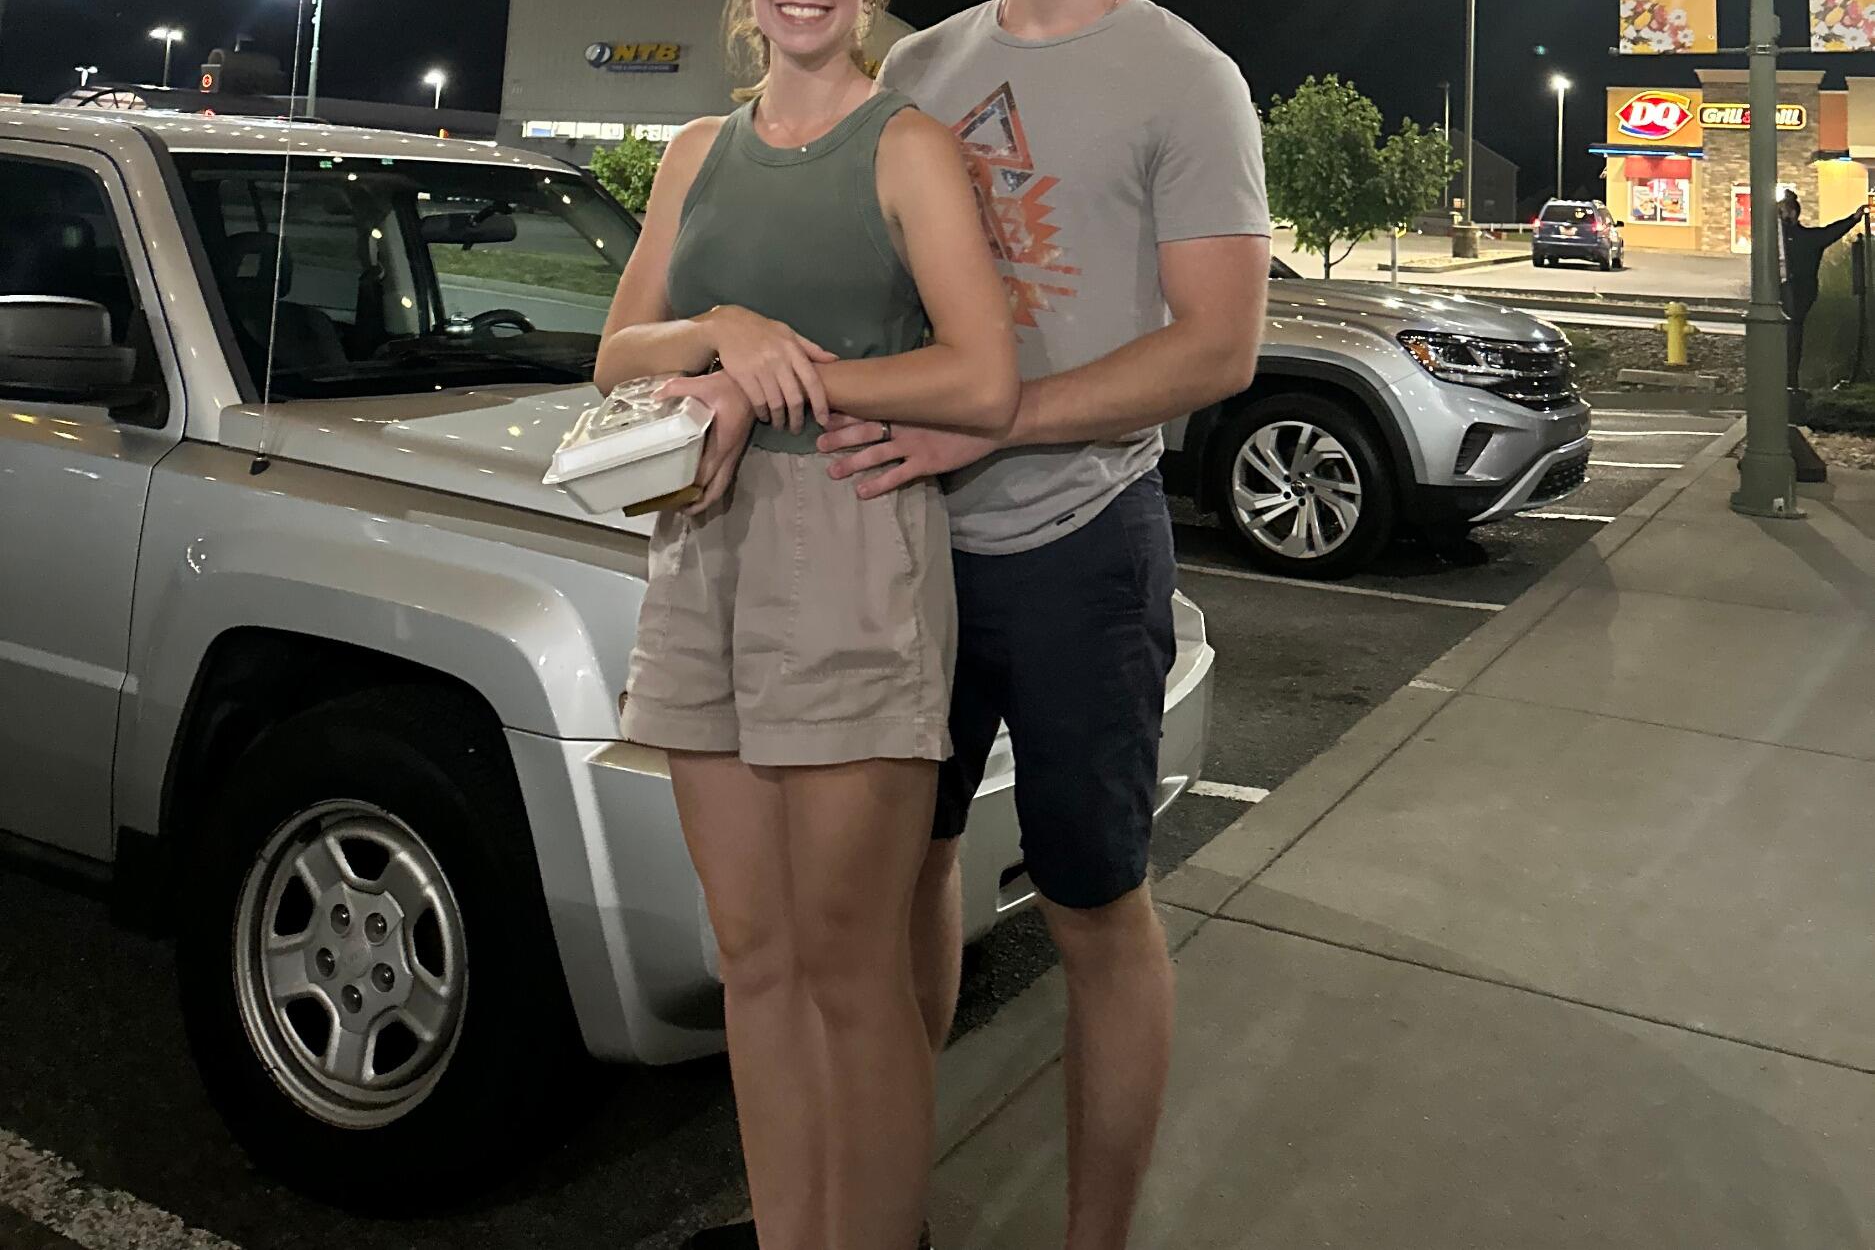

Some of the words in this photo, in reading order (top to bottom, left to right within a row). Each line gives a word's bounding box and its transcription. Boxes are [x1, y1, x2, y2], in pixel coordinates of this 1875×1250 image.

[612, 43, 680, 62] NTB
[1628, 101, 1681, 130] DQ
[1702, 107, 1744, 124] Grill
[1775, 108, 1801, 125] ill
